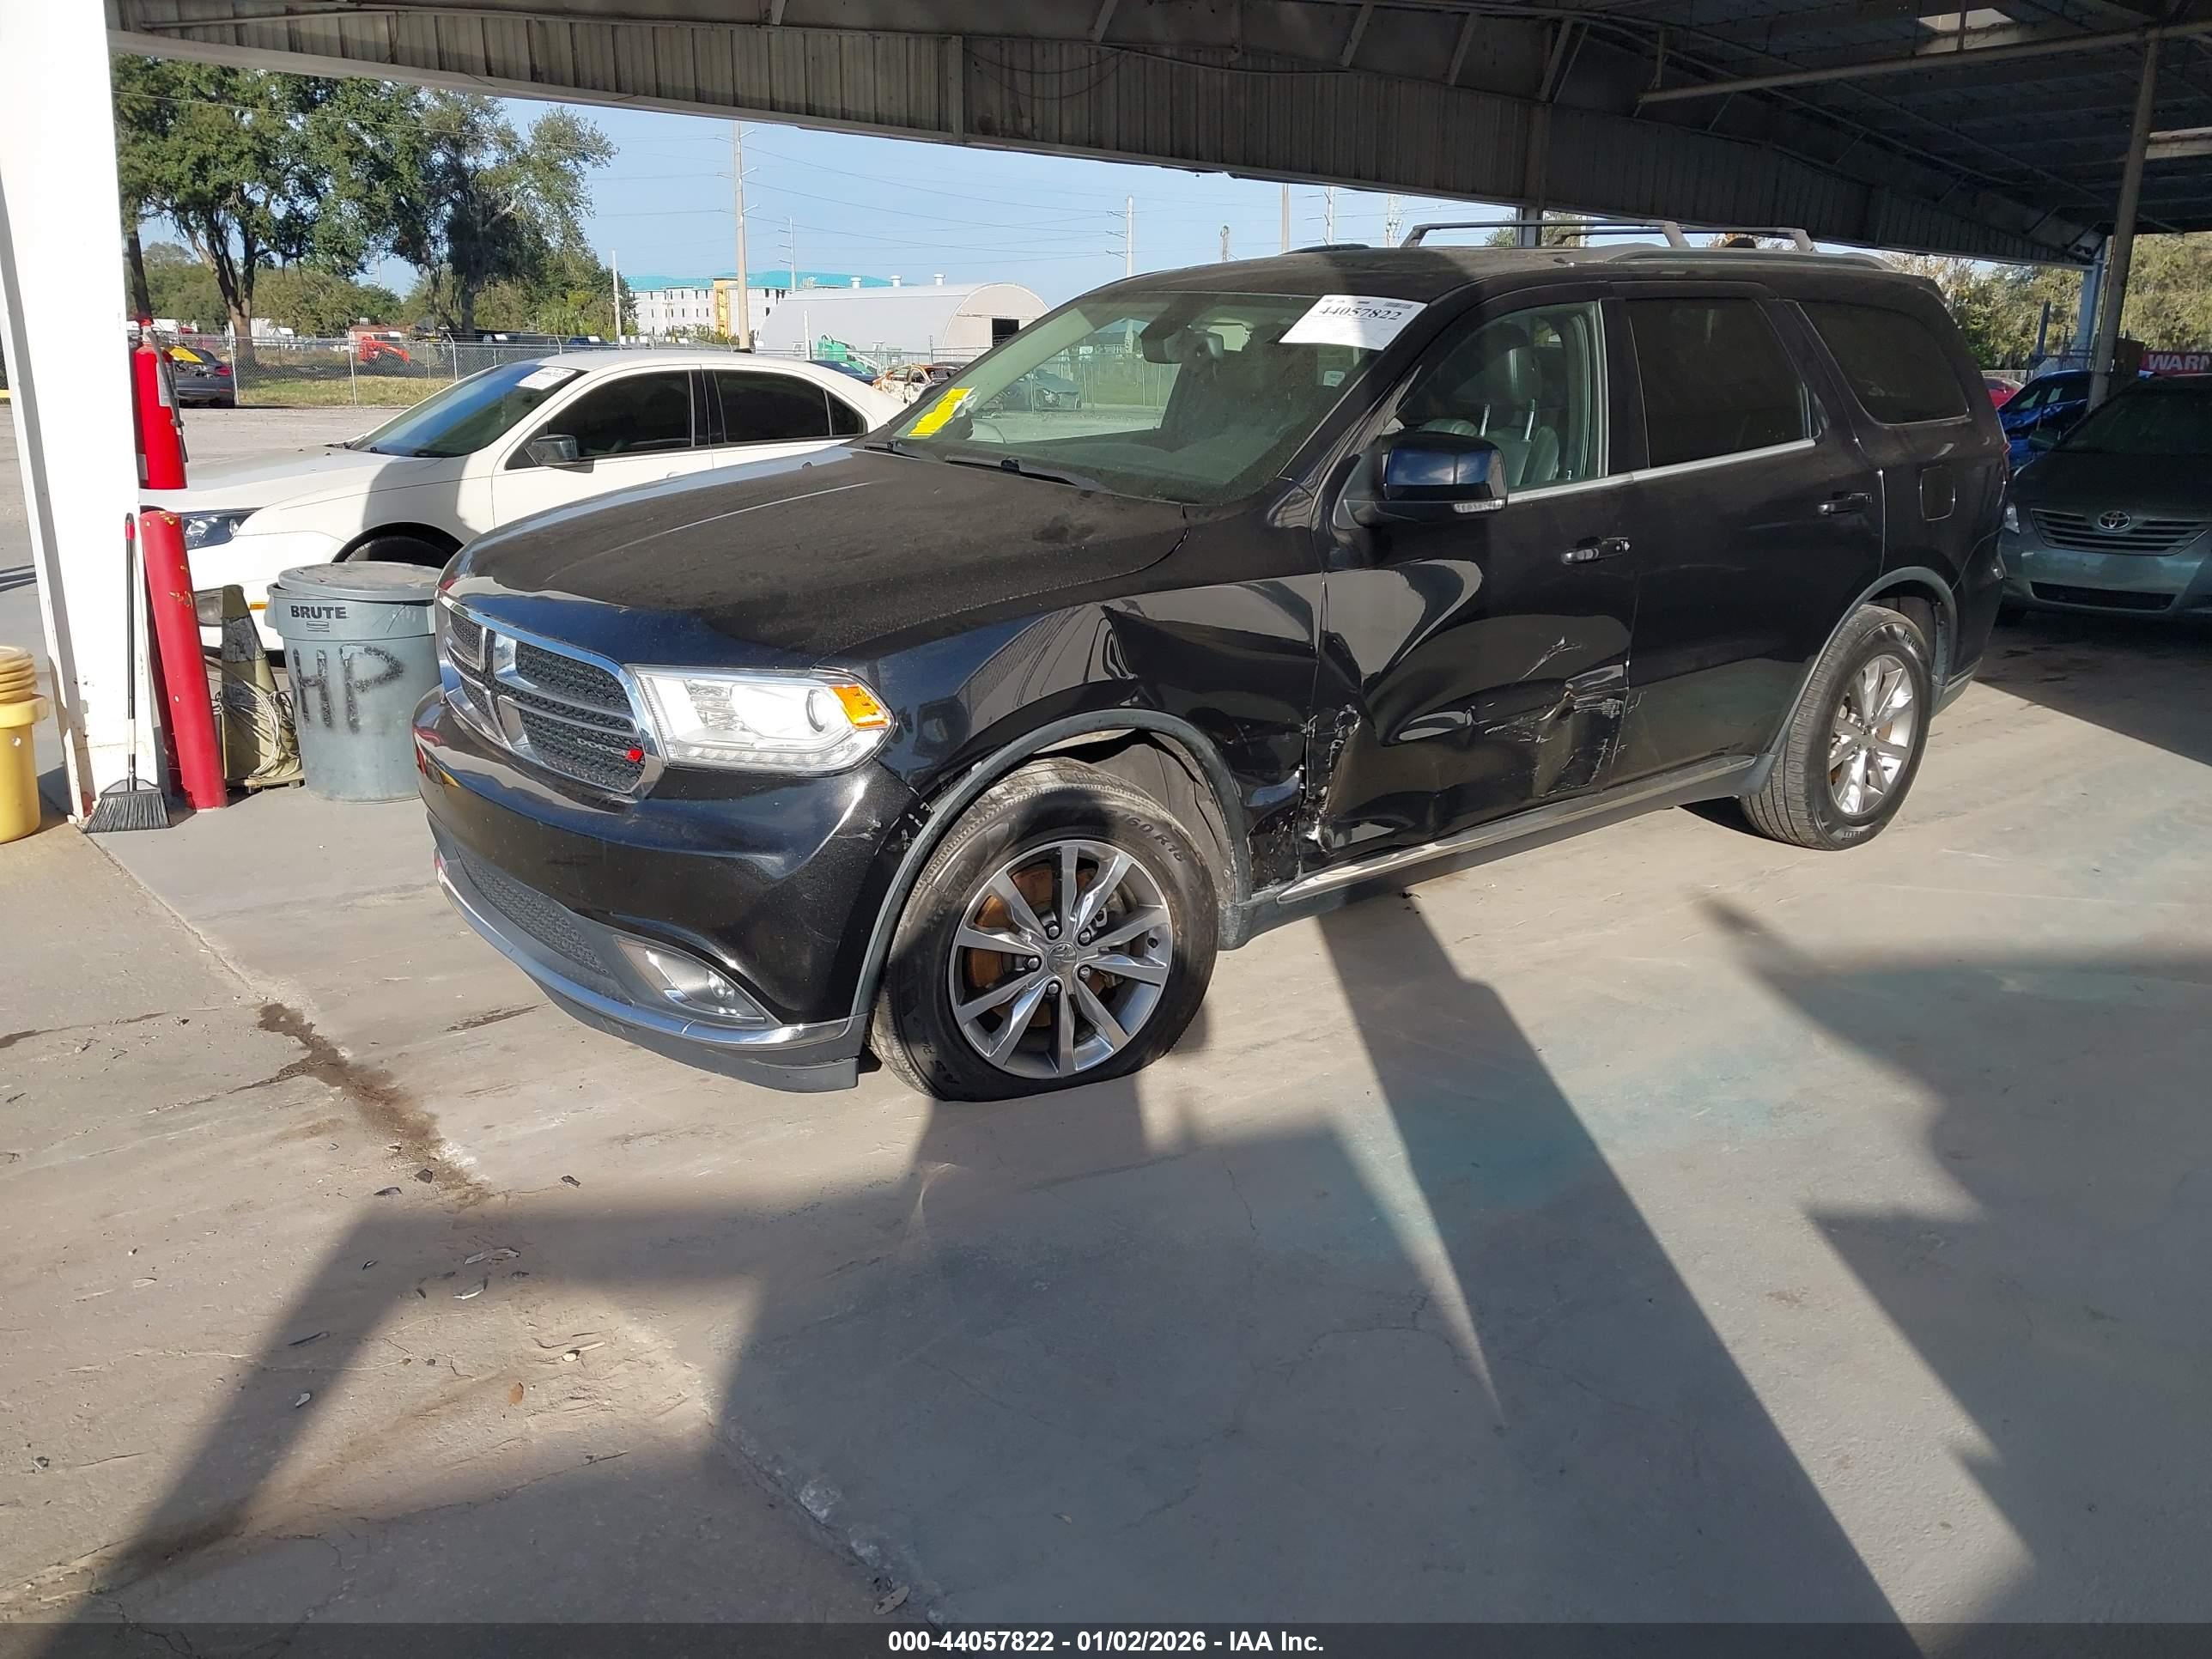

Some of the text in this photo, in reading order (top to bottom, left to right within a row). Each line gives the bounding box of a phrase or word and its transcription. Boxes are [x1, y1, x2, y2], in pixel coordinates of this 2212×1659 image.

[1318, 306, 1402, 320] 44057822
[290, 605, 347, 619] BRUTE
[292, 643, 404, 735] HP
